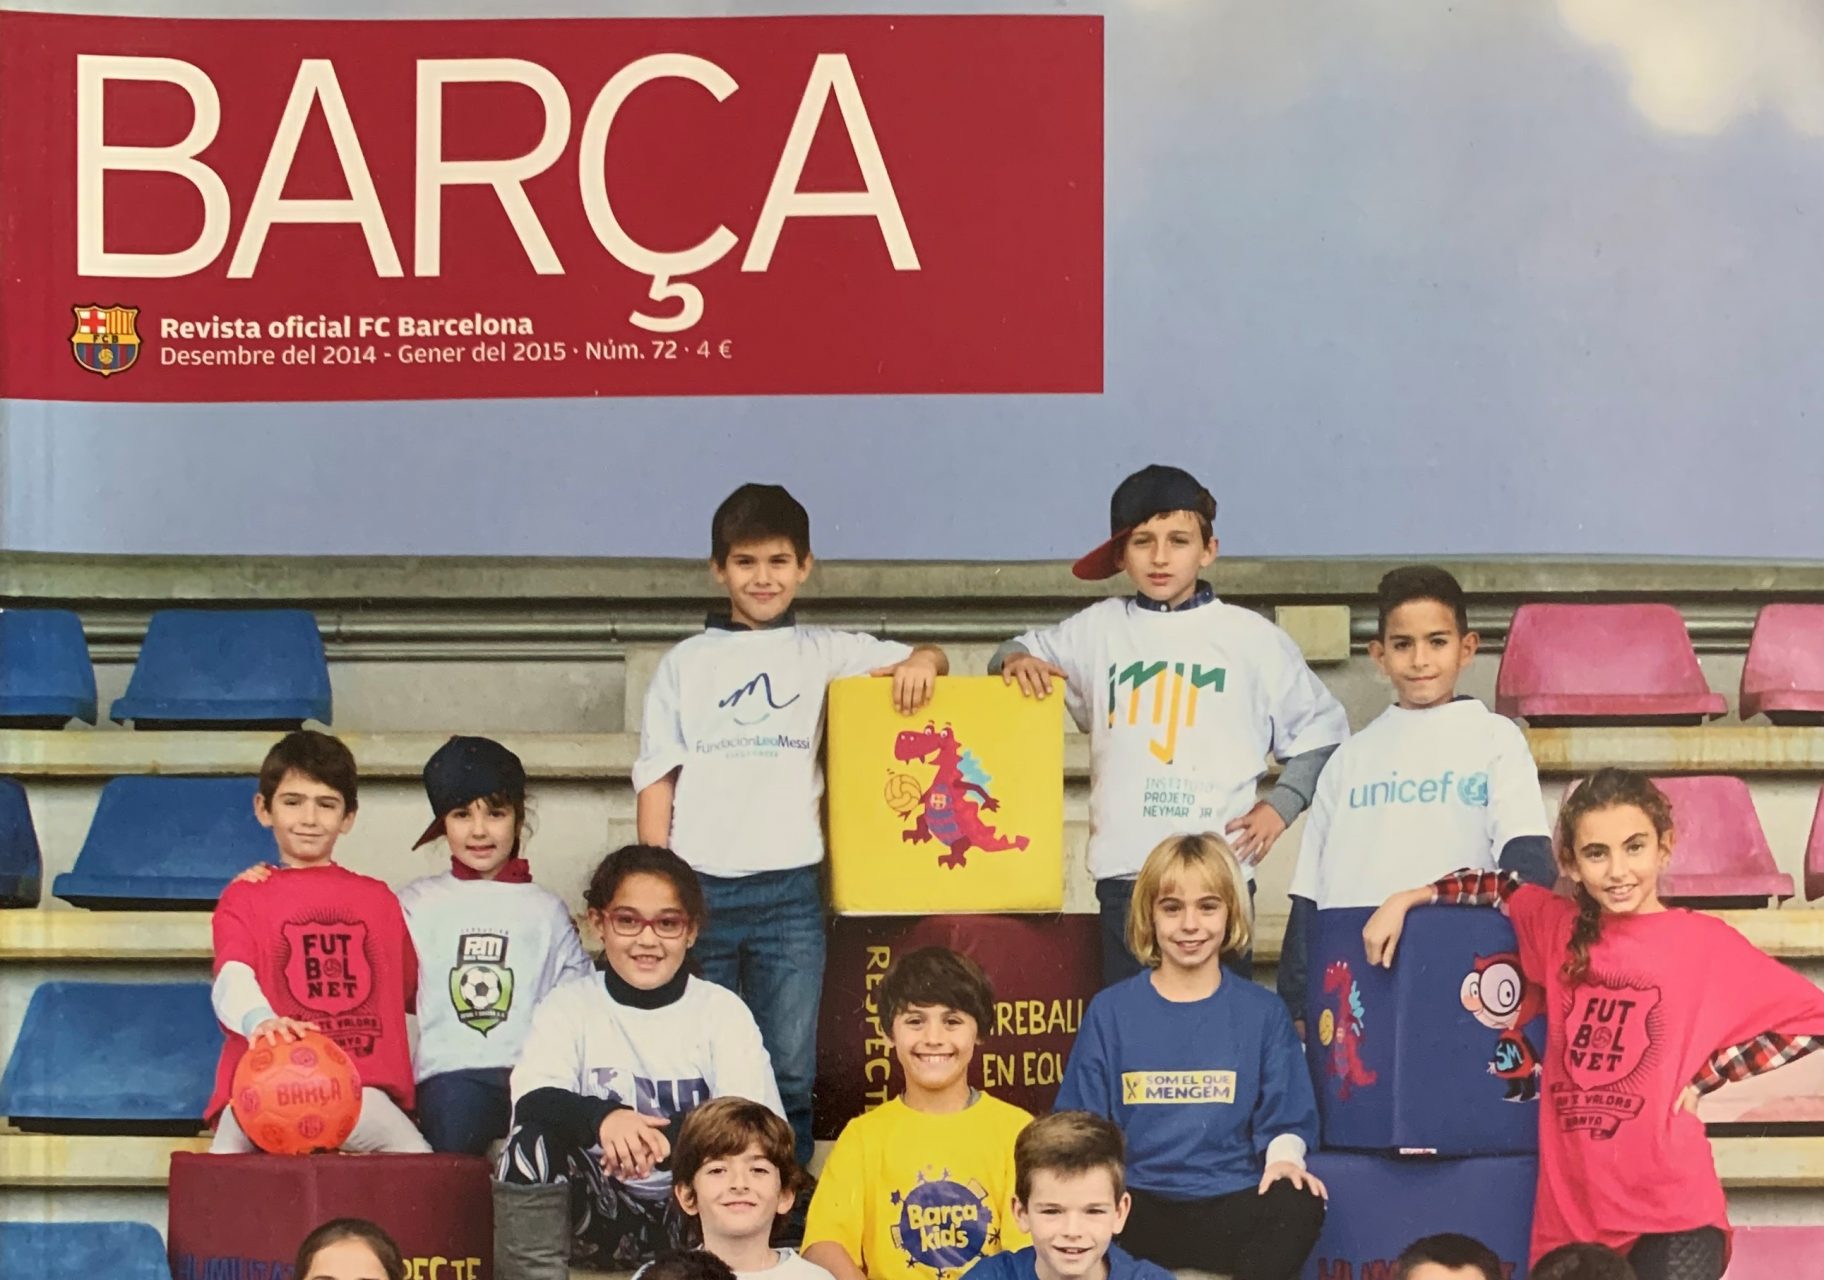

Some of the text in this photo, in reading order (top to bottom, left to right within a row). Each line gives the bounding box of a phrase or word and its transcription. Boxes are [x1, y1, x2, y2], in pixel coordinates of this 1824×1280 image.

[76, 53, 921, 331] BARÇA
[160, 313, 534, 339] Revista oficial FC Barcelona
[160, 346, 275, 365] Desembre
[281, 346, 316, 364] del
[323, 346, 377, 364] 2014
[398, 344, 465, 363] Gener
[471, 341, 506, 361] del
[513, 342, 566, 361] 2015
[585, 339, 645, 359] Núm.
[652, 340, 678, 359] 72
[696, 341, 711, 358] 4
[718, 340, 733, 359] €
[1144, 791, 1196, 806] PROJETO
[1349, 771, 1454, 808] unicef
[1143, 805, 1190, 818] NEYMAR
[302, 933, 352, 956] FUT
[307, 982, 357, 999] NET
[990, 998, 1083, 1037] REBALL
[1584, 998, 1636, 1025] FUT
[864, 946, 892, 1112] RESPECT
[982, 1052, 1064, 1088] EN EQU
[1570, 1049, 1623, 1072] NET
[1145, 1086, 1230, 1099] MENGEM
[1146, 1075, 1178, 1085] SOM
[1182, 1075, 1198, 1085] EL
[907, 1204, 978, 1230] Barça
[920, 1222, 969, 1252] kids
